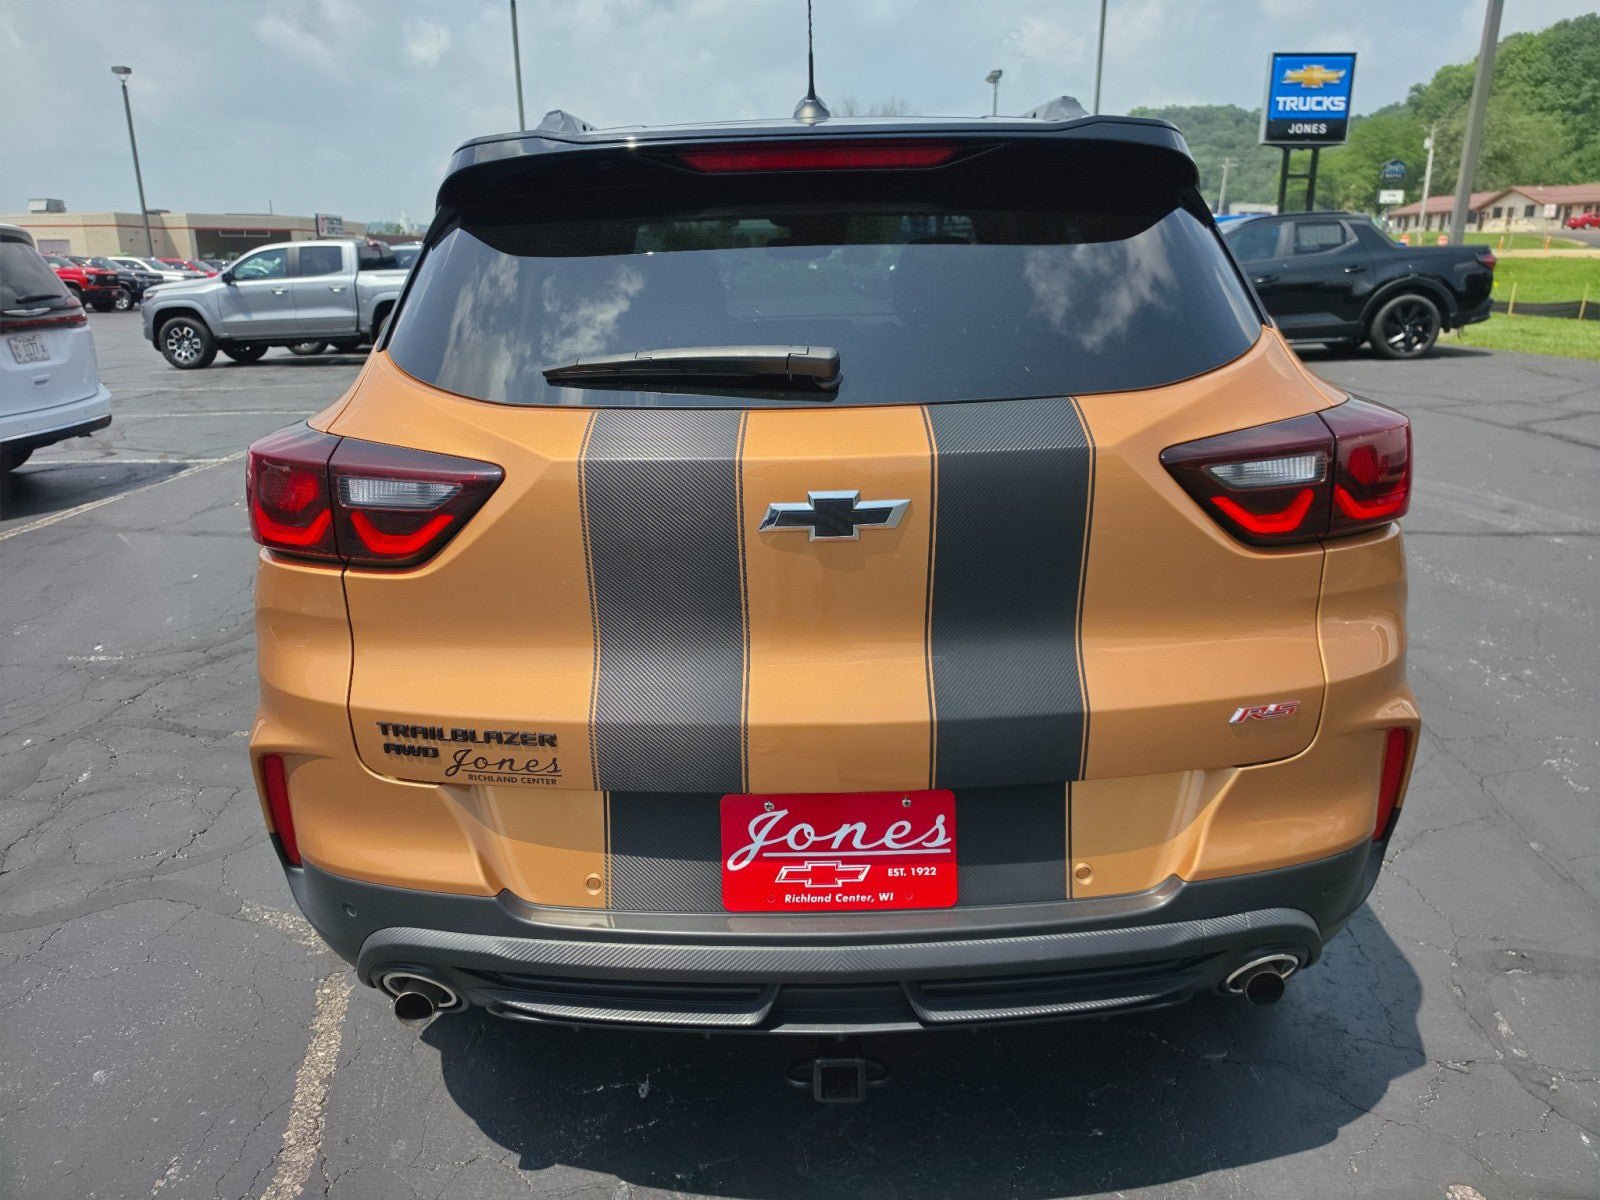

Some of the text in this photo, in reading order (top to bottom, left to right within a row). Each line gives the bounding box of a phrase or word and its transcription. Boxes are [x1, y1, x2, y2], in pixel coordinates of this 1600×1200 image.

[1275, 96, 1346, 111] TRUCKS
[1288, 123, 1327, 134] JONES
[1229, 700, 1300, 722] RS
[376, 721, 557, 747] TRAILBLAZER
[383, 742, 438, 758] AWD
[444, 748, 562, 777] Jones
[468, 773, 557, 785] RICHLAND CENTER
[727, 809, 951, 871] Jones
[887, 867, 937, 877] EST. 1922
[784, 893, 894, 903] Richland Center, WI
